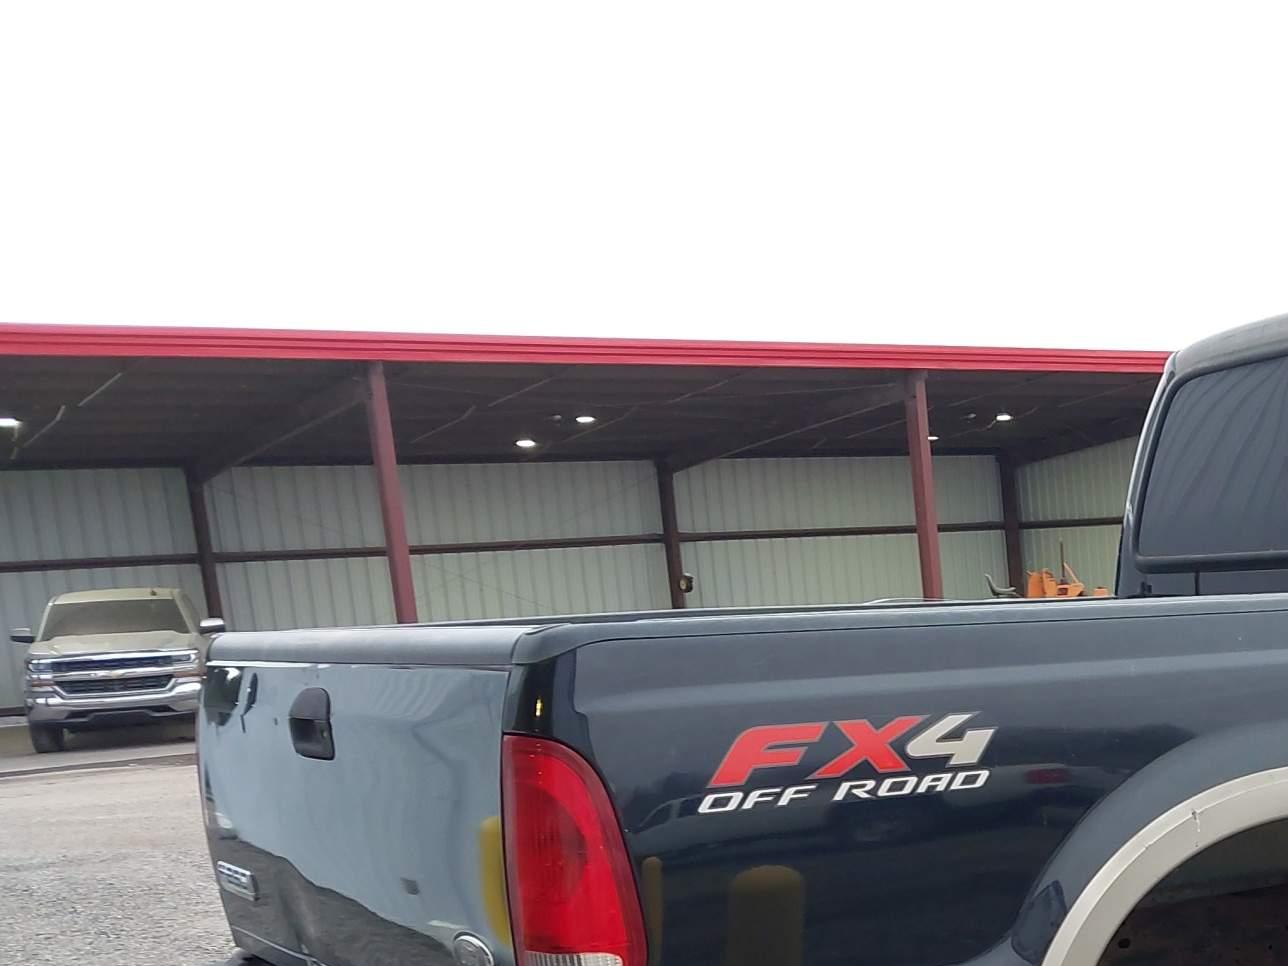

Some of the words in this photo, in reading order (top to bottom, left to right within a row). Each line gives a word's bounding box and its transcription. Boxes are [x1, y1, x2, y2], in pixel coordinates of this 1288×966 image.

[706, 711, 998, 788] FX4
[698, 783, 816, 814] OFF
[832, 769, 991, 801] ROAD
